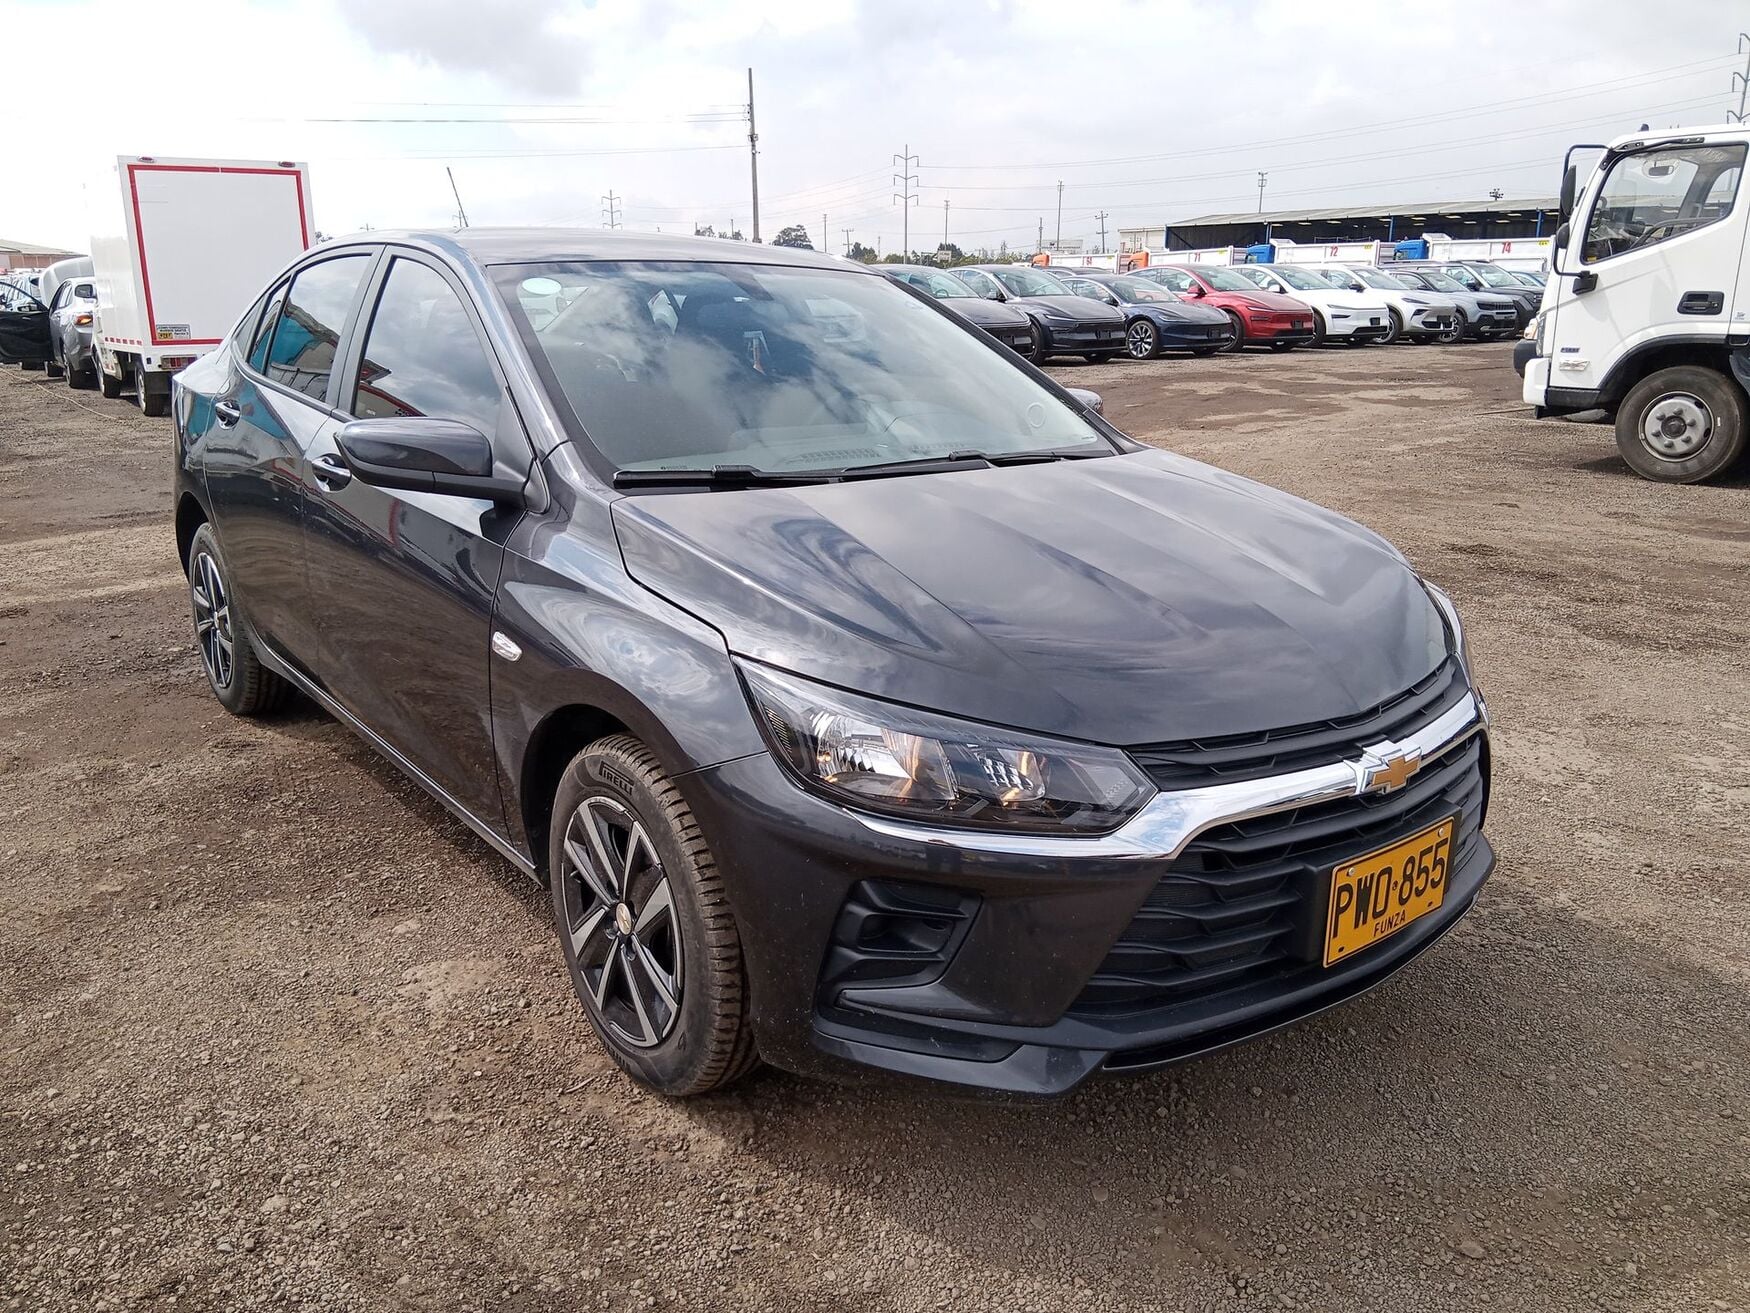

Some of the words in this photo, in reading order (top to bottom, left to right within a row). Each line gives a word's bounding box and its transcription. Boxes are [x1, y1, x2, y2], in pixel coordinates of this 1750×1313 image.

[1330, 245, 1339, 257] 72
[1502, 241, 1512, 254] 74
[598, 760, 635, 796] PIRELLI
[1373, 909, 1406, 937] FUNZA
